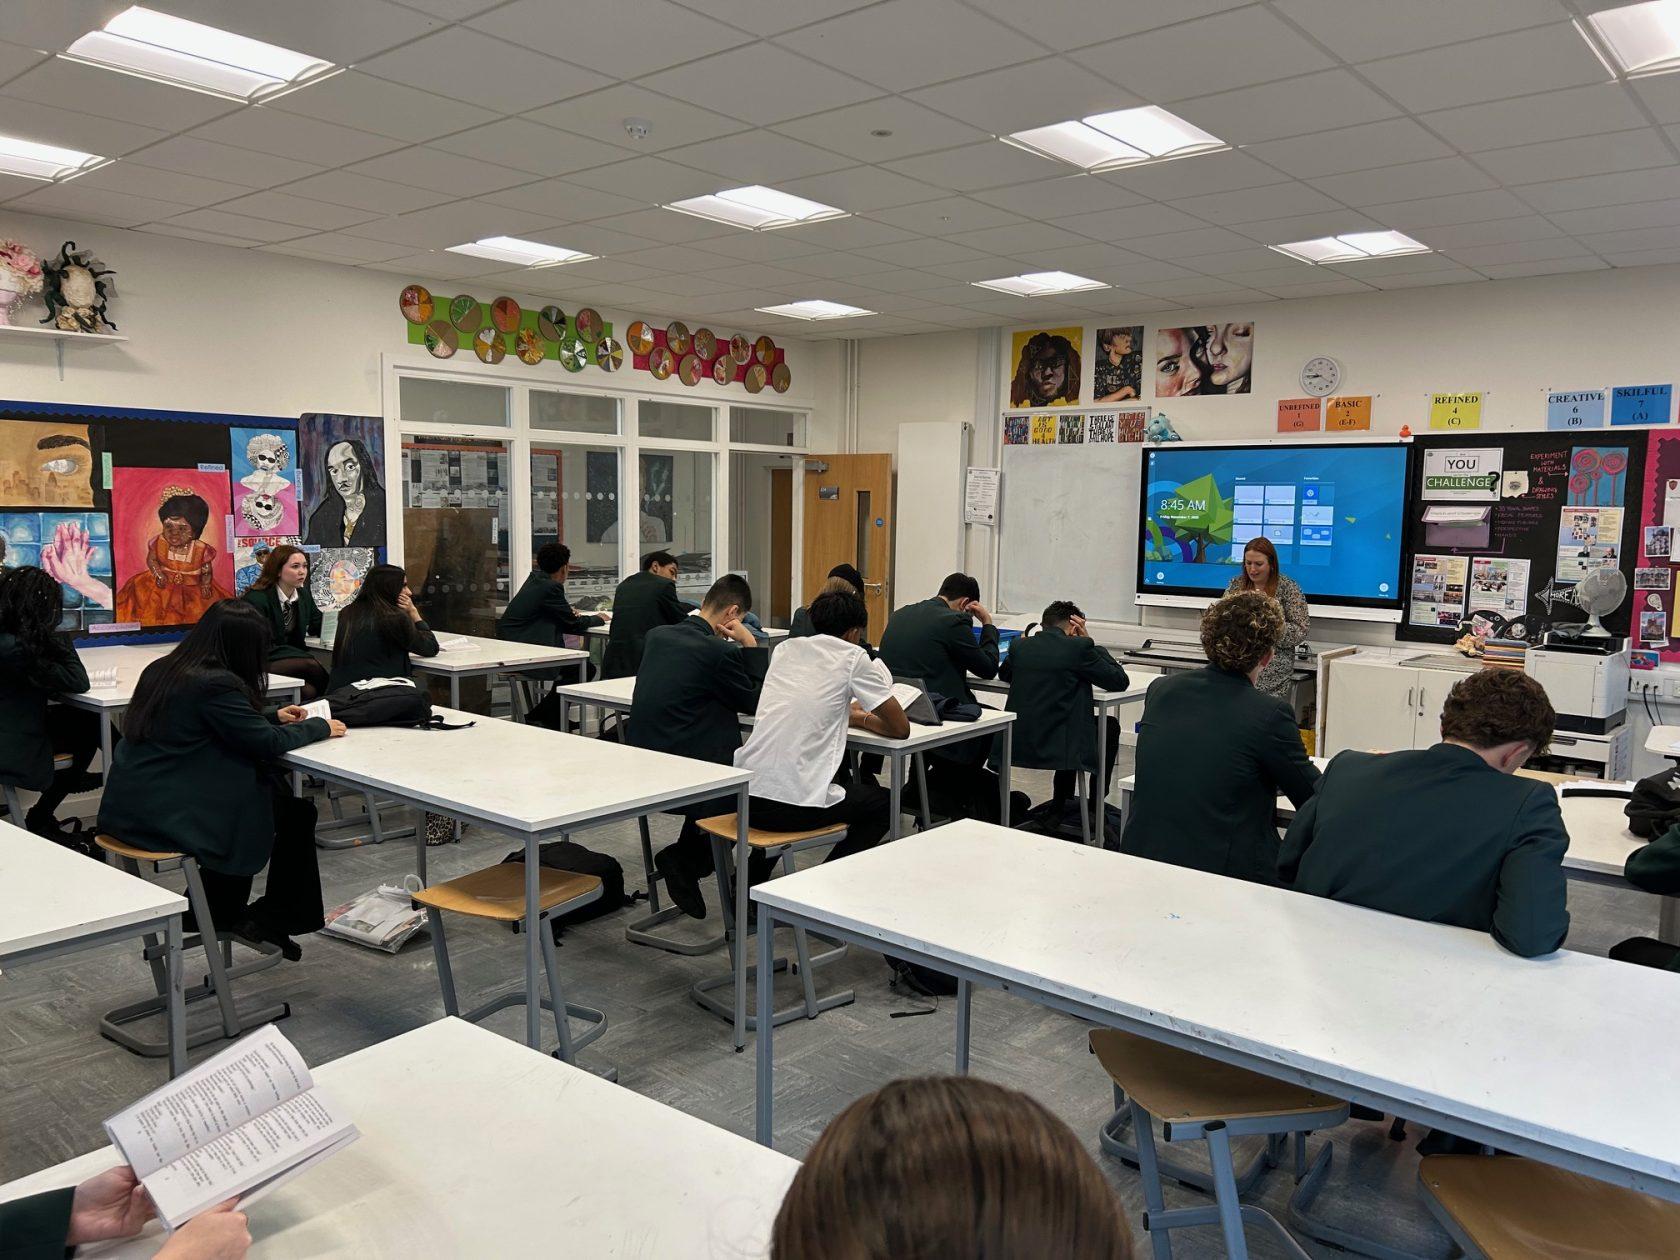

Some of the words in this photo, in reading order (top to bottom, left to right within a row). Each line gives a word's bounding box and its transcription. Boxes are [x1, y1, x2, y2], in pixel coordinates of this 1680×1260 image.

[1616, 387, 1667, 397] SKILFUL
[1435, 396, 1478, 404] REFINED
[1548, 393, 1605, 404] CREATIVE
[1279, 403, 1320, 411] UNREFINED
[1335, 400, 1362, 408] BASIC
[1638, 400, 1644, 408] 7
[1632, 412, 1648, 421] (A)
[1448, 418, 1461, 426] (C)
[1567, 417, 1582, 426] (B)
[1530, 450, 1568, 459] EXPERIMENT
[1447, 459, 1476, 470] YOU
[1533, 464, 1566, 472] MATERIALS
[1161, 499, 1184, 511] 8:45
[1187, 499, 1206, 511] AM
[1551, 590, 1572, 602] MORE
